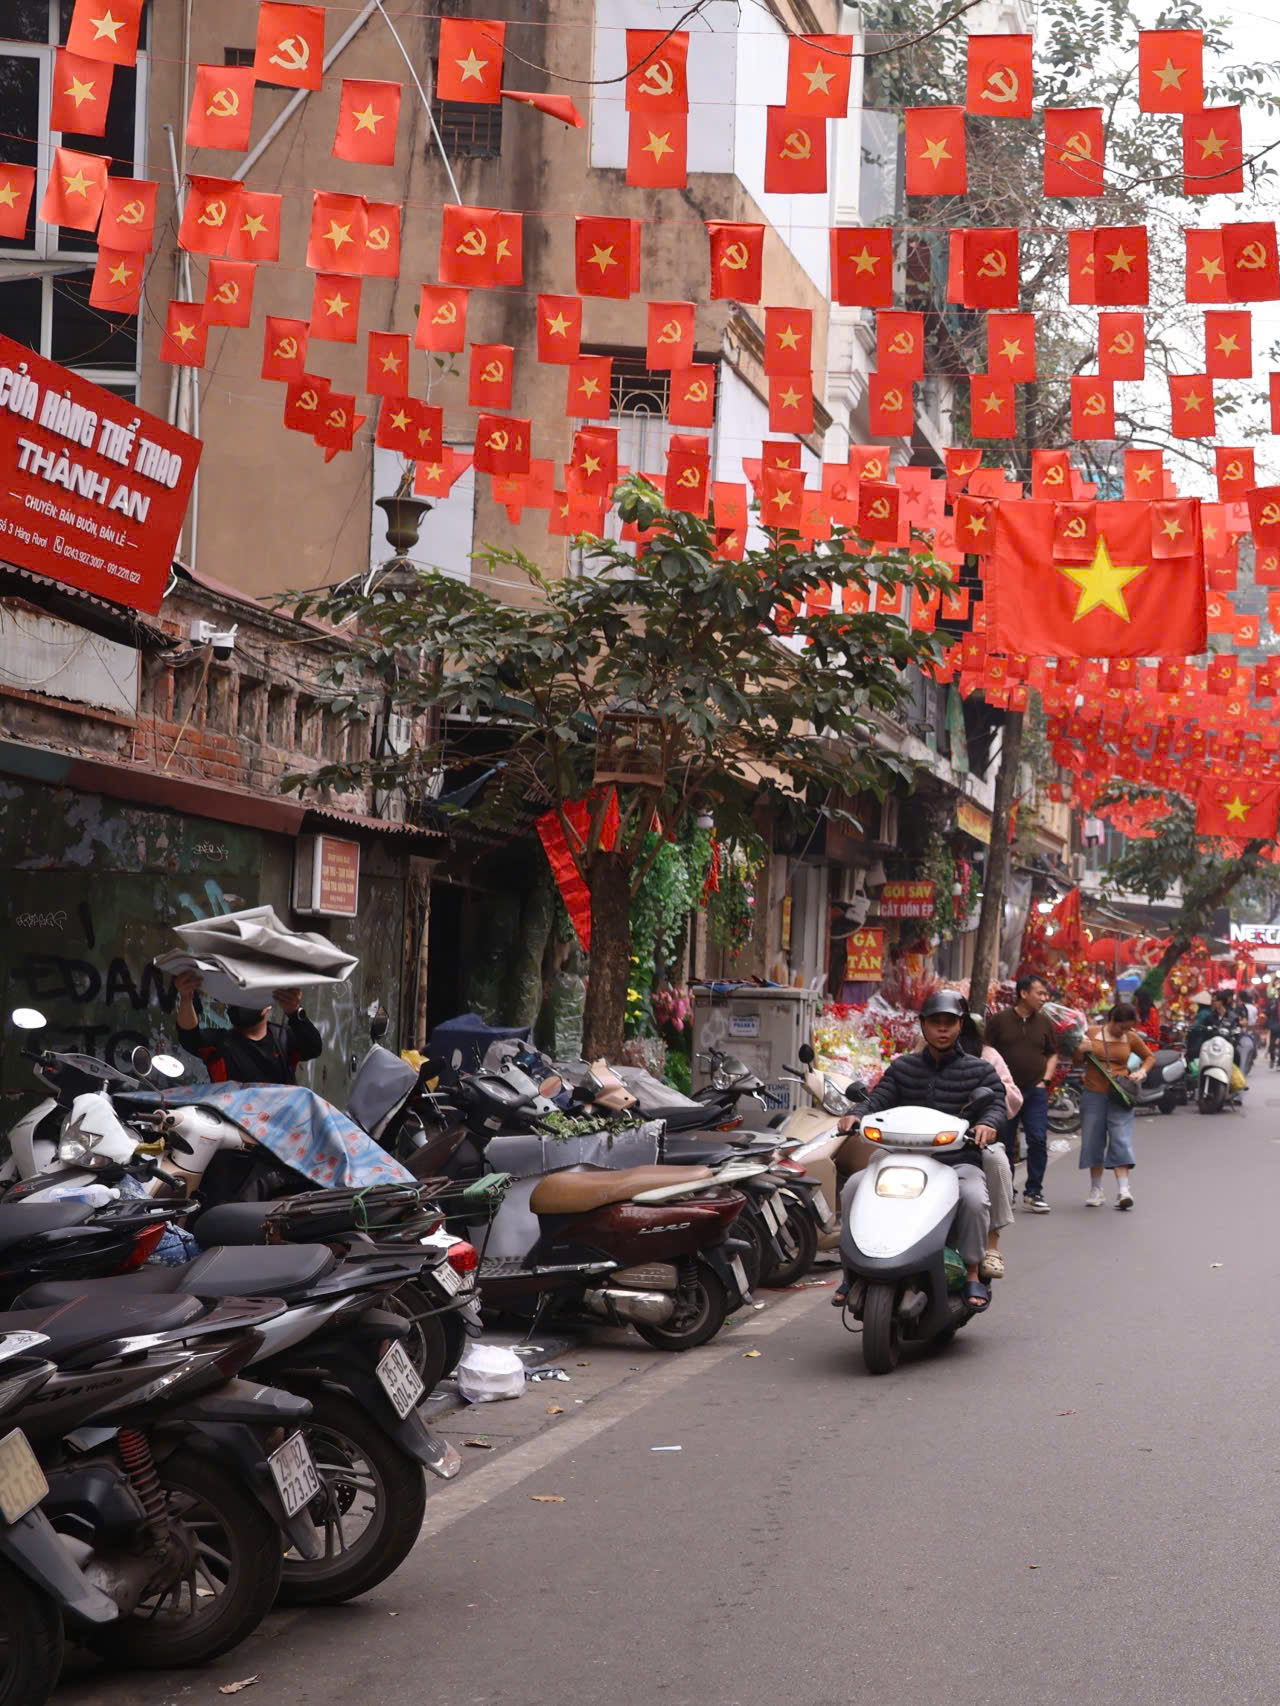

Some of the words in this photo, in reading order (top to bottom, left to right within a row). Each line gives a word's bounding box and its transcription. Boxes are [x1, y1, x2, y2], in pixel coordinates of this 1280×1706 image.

[17, 437, 110, 505] THÀNH
[108, 484, 151, 523] AN
[39, 390, 98, 448] HÀNG
[133, 437, 182, 489] THAO
[283, 1465, 318, 1514] 273.19
